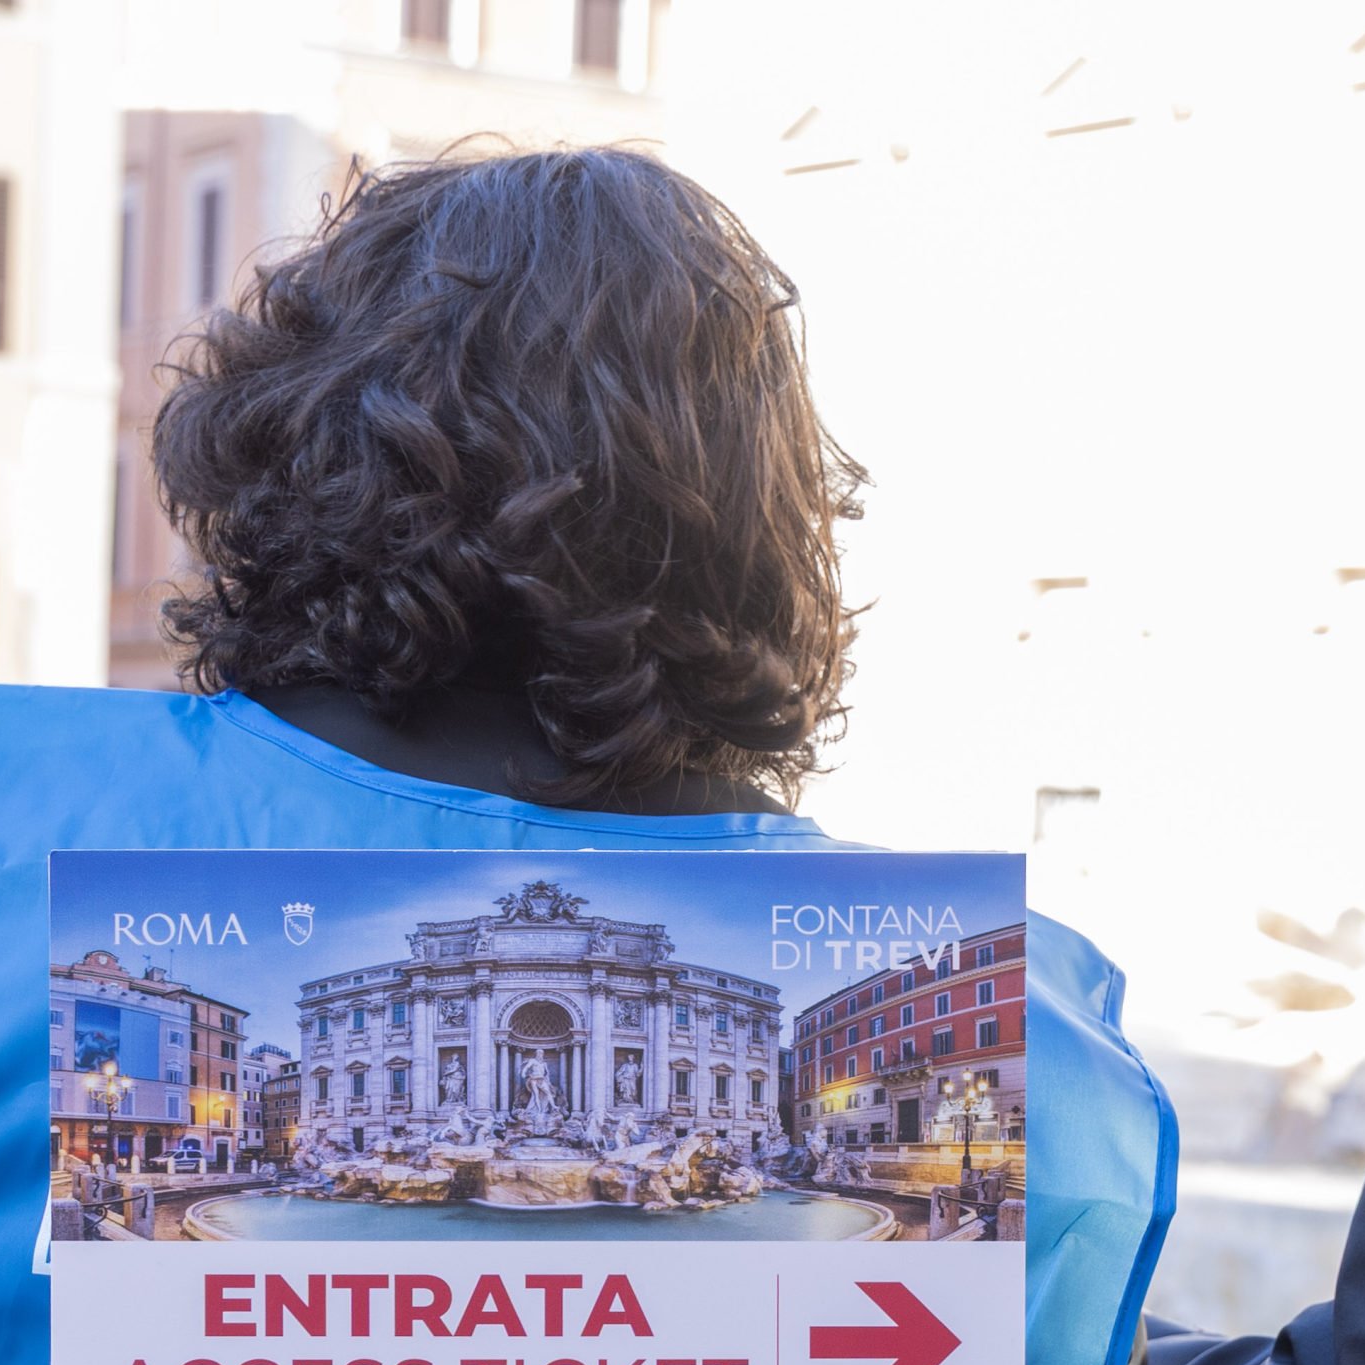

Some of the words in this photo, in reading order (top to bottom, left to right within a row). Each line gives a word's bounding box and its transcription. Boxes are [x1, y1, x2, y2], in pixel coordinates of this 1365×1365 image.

[113, 912, 248, 946] ROMA
[771, 904, 964, 936] FONTANA
[771, 940, 811, 971] DI
[824, 940, 961, 971] TREVI
[204, 1273, 655, 1338] ENTRATA
